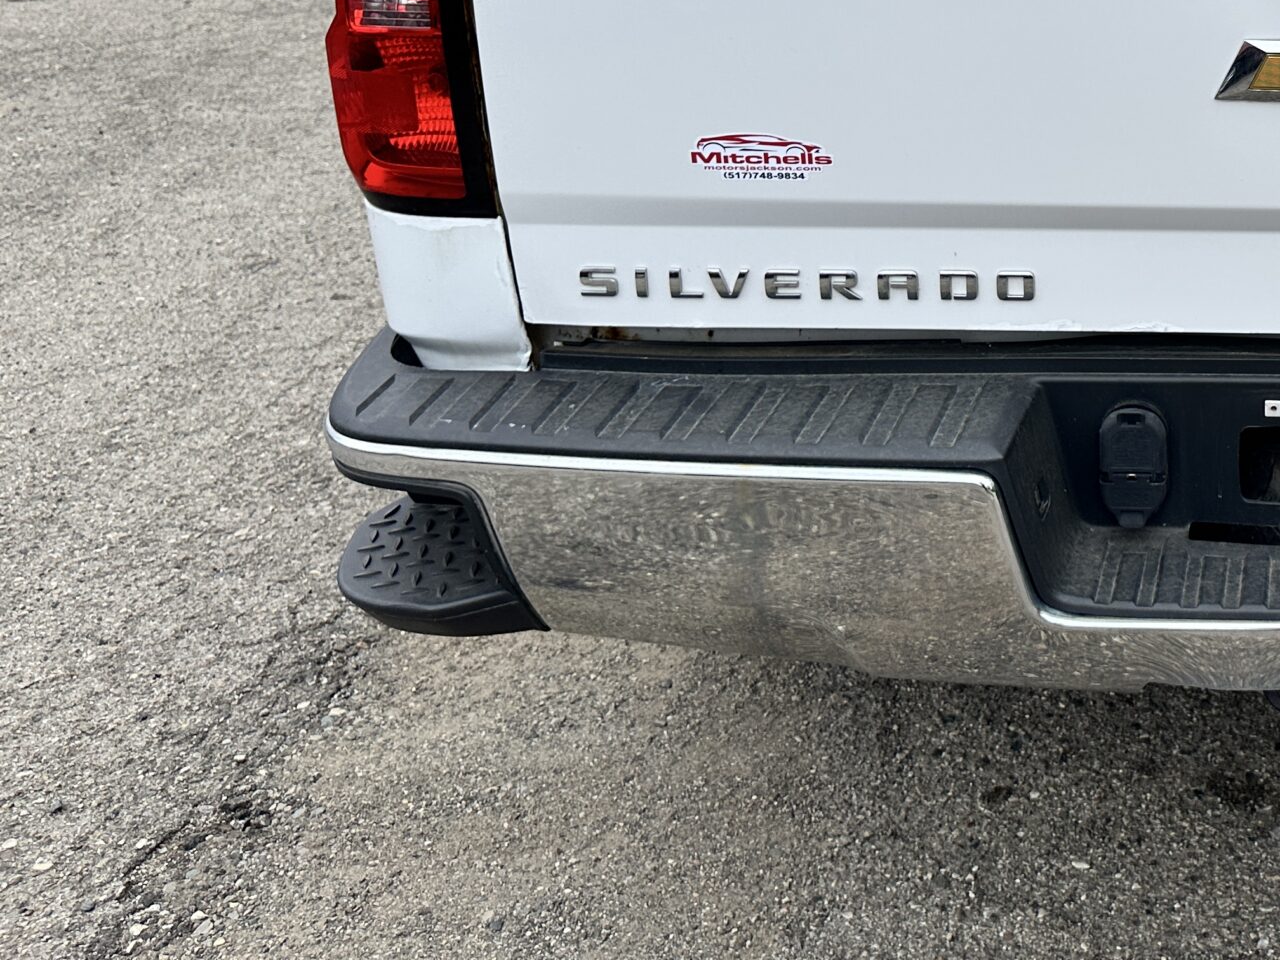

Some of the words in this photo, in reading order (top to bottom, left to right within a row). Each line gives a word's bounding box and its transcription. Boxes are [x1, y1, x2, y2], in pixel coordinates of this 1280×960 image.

[690, 151, 833, 165] Mitchells
[704, 164, 822, 172] motorsjackson.com
[723, 172, 805, 180] (517)748-9834
[579, 265, 1036, 301] SILVERADO
